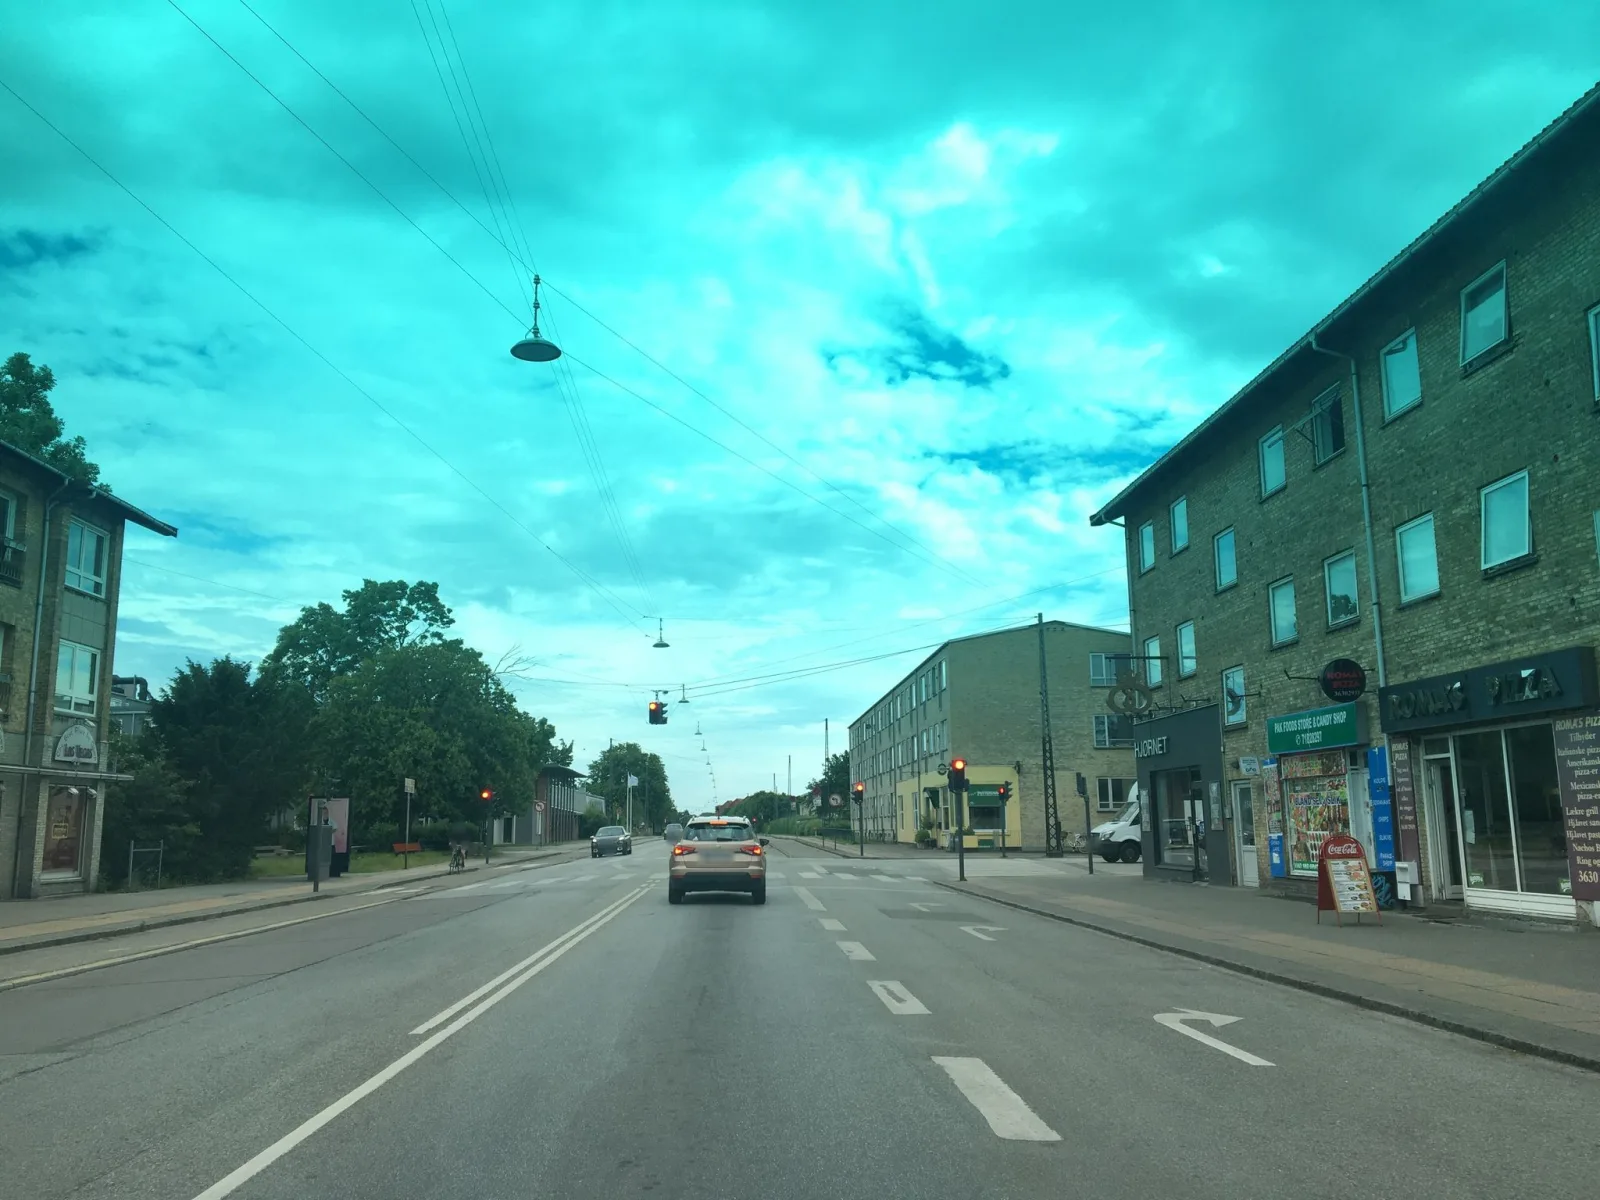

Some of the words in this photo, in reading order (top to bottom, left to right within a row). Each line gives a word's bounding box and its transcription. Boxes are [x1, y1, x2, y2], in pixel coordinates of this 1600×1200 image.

[1484, 667, 1562, 706] PIZZA
[1274, 723, 1283, 734] PAK
[1283, 720, 1297, 732] FOODS
[1298, 718, 1312, 731] STORE
[1316, 713, 1332, 728] CANDY
[1333, 711, 1347, 725] SHOP
[1568, 731, 1596, 743] Tilbyder
[1395, 753, 1407, 761] PIZZA
[1586, 806, 1599, 818] grill
[1328, 843, 1358, 855] Coca-Cola
[1576, 856, 1592, 868] Ring
[1578, 870, 1599, 883] 3630
